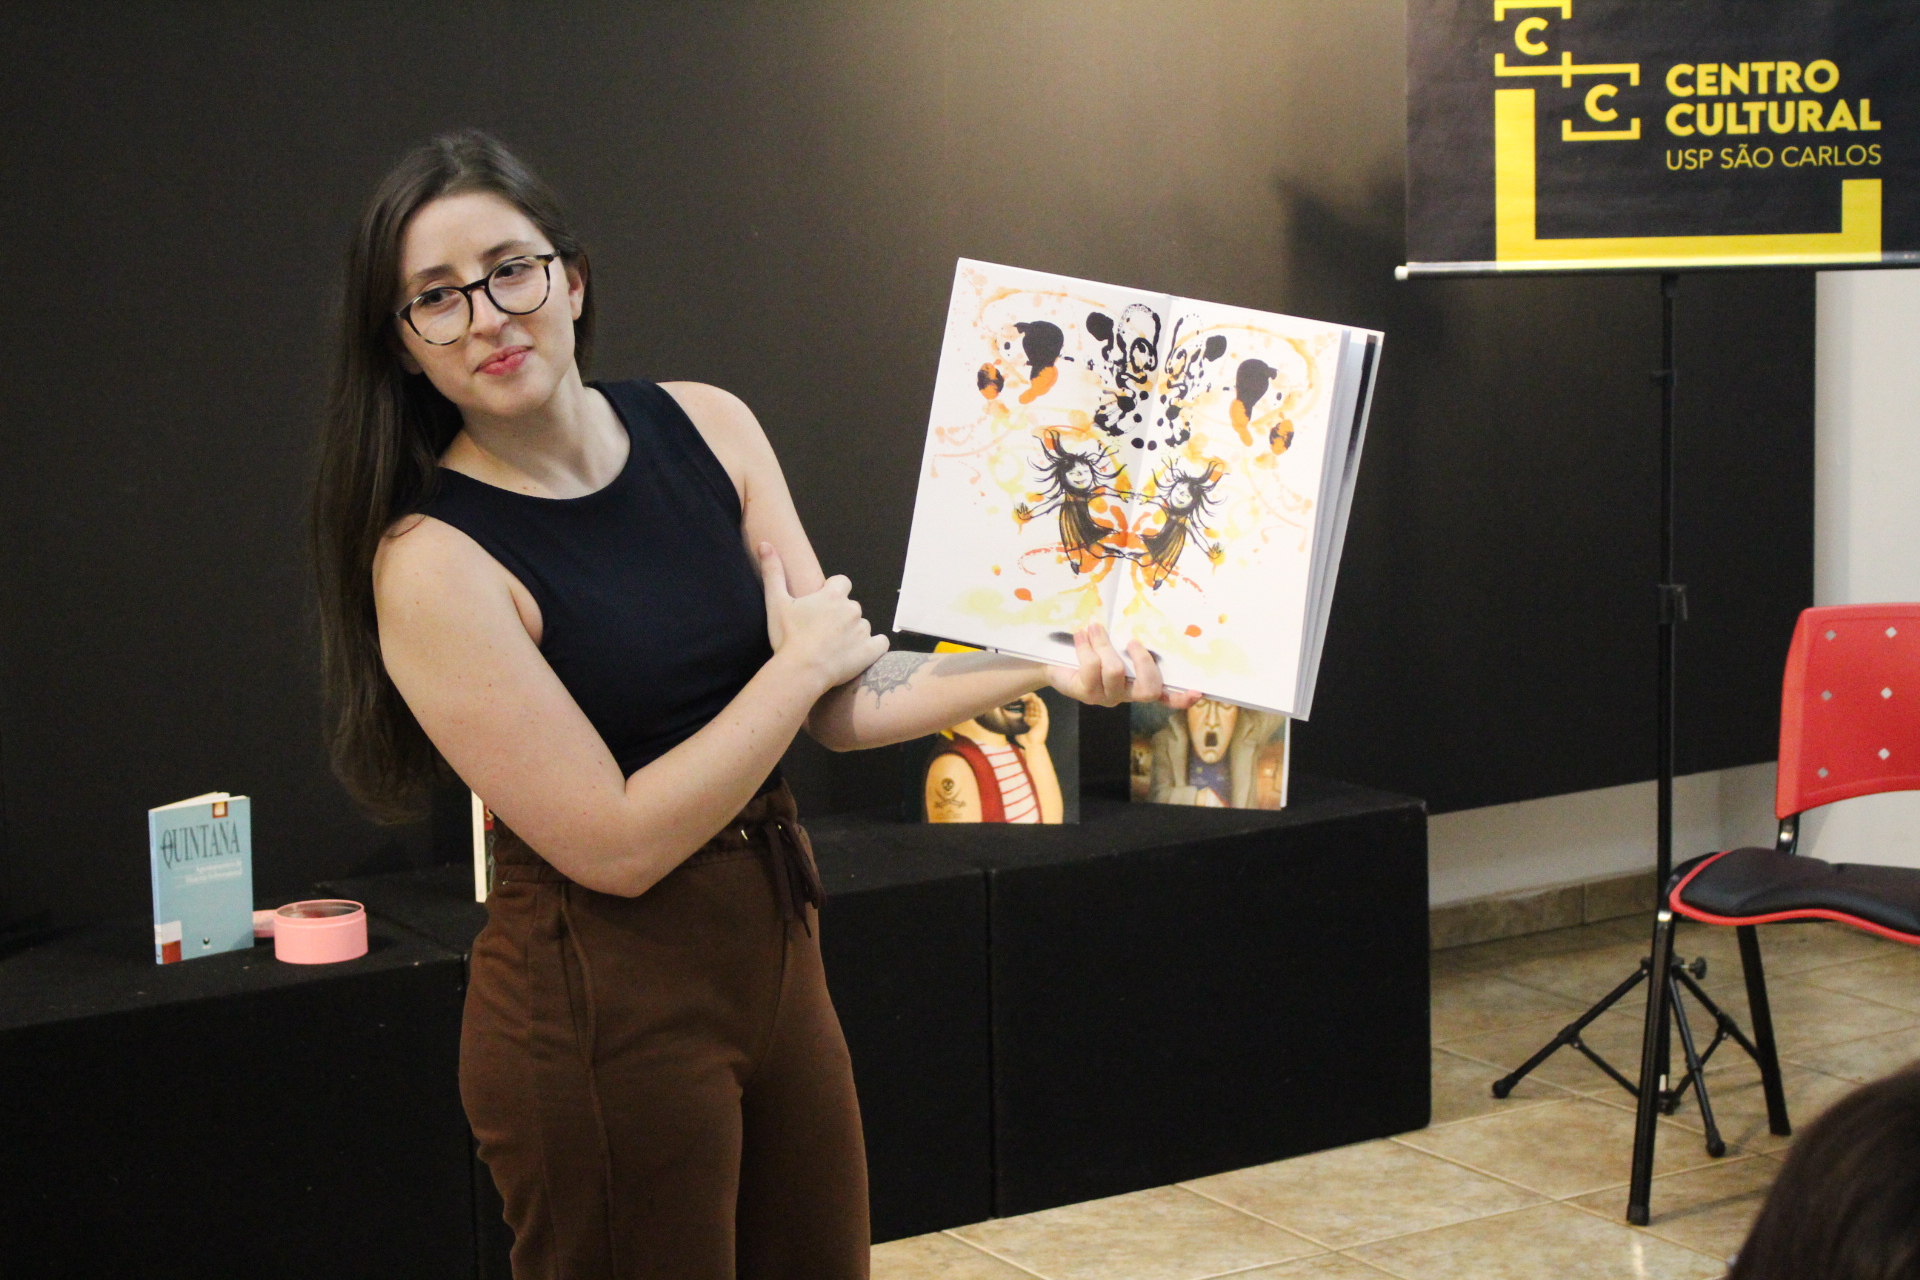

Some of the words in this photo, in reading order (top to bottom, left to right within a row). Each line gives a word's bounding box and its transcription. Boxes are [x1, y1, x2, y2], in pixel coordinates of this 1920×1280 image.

[1514, 17, 1549, 56] C
[1665, 58, 1840, 98] CENTRO
[1584, 83, 1619, 123] C
[1665, 98, 1882, 137] CULTURAL
[1666, 148, 1714, 171] USP
[1720, 143, 1775, 170] SÃO
[1781, 143, 1883, 168] CARLOS
[160, 820, 242, 870] QUINTANA
